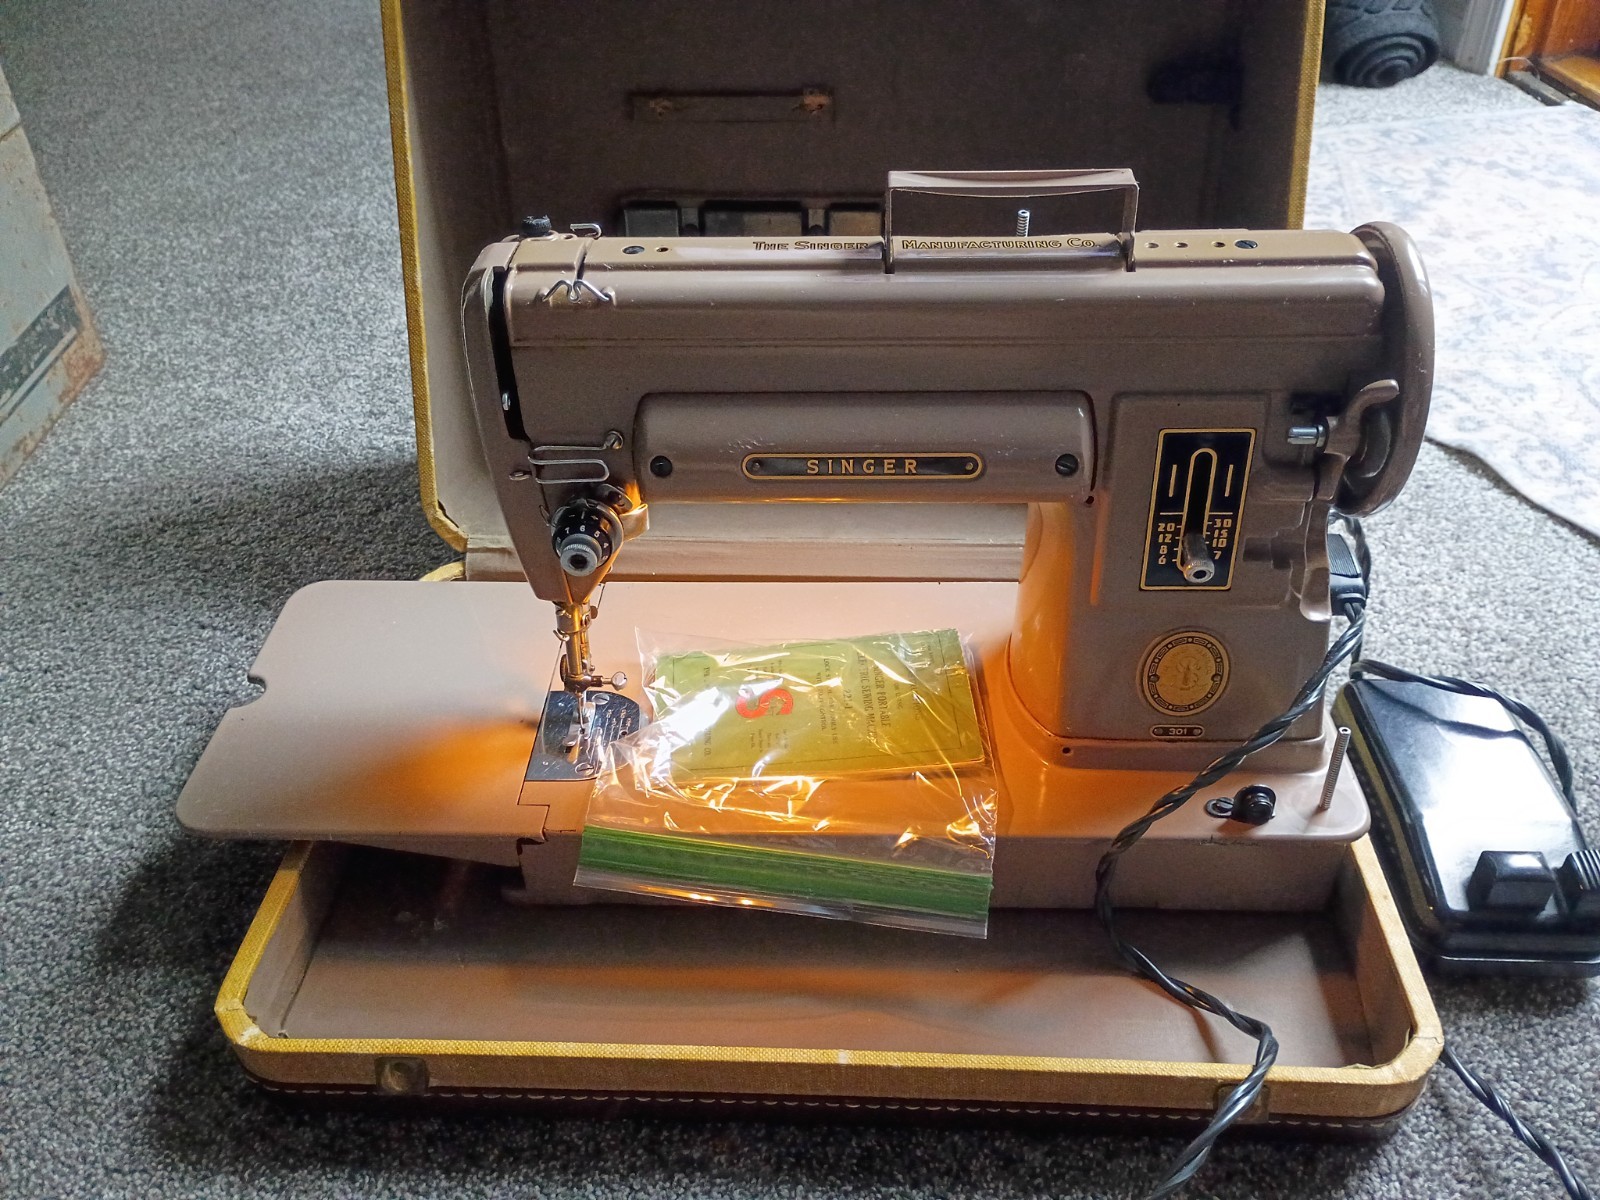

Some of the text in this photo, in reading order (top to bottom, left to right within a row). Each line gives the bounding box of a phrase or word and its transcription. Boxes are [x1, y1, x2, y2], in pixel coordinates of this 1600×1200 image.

[806, 459, 918, 474] SINGER
[1157, 523, 1175, 532] 20
[1214, 519, 1232, 528] 30
[1158, 533, 1173, 543] 12
[1213, 529, 1228, 538] 15
[1212, 538, 1227, 548] 10
[1159, 545, 1168, 554] 8
[1158, 555, 1167, 565] 6
[1213, 551, 1222, 560] 7
[1168, 727, 1187, 735] 301
